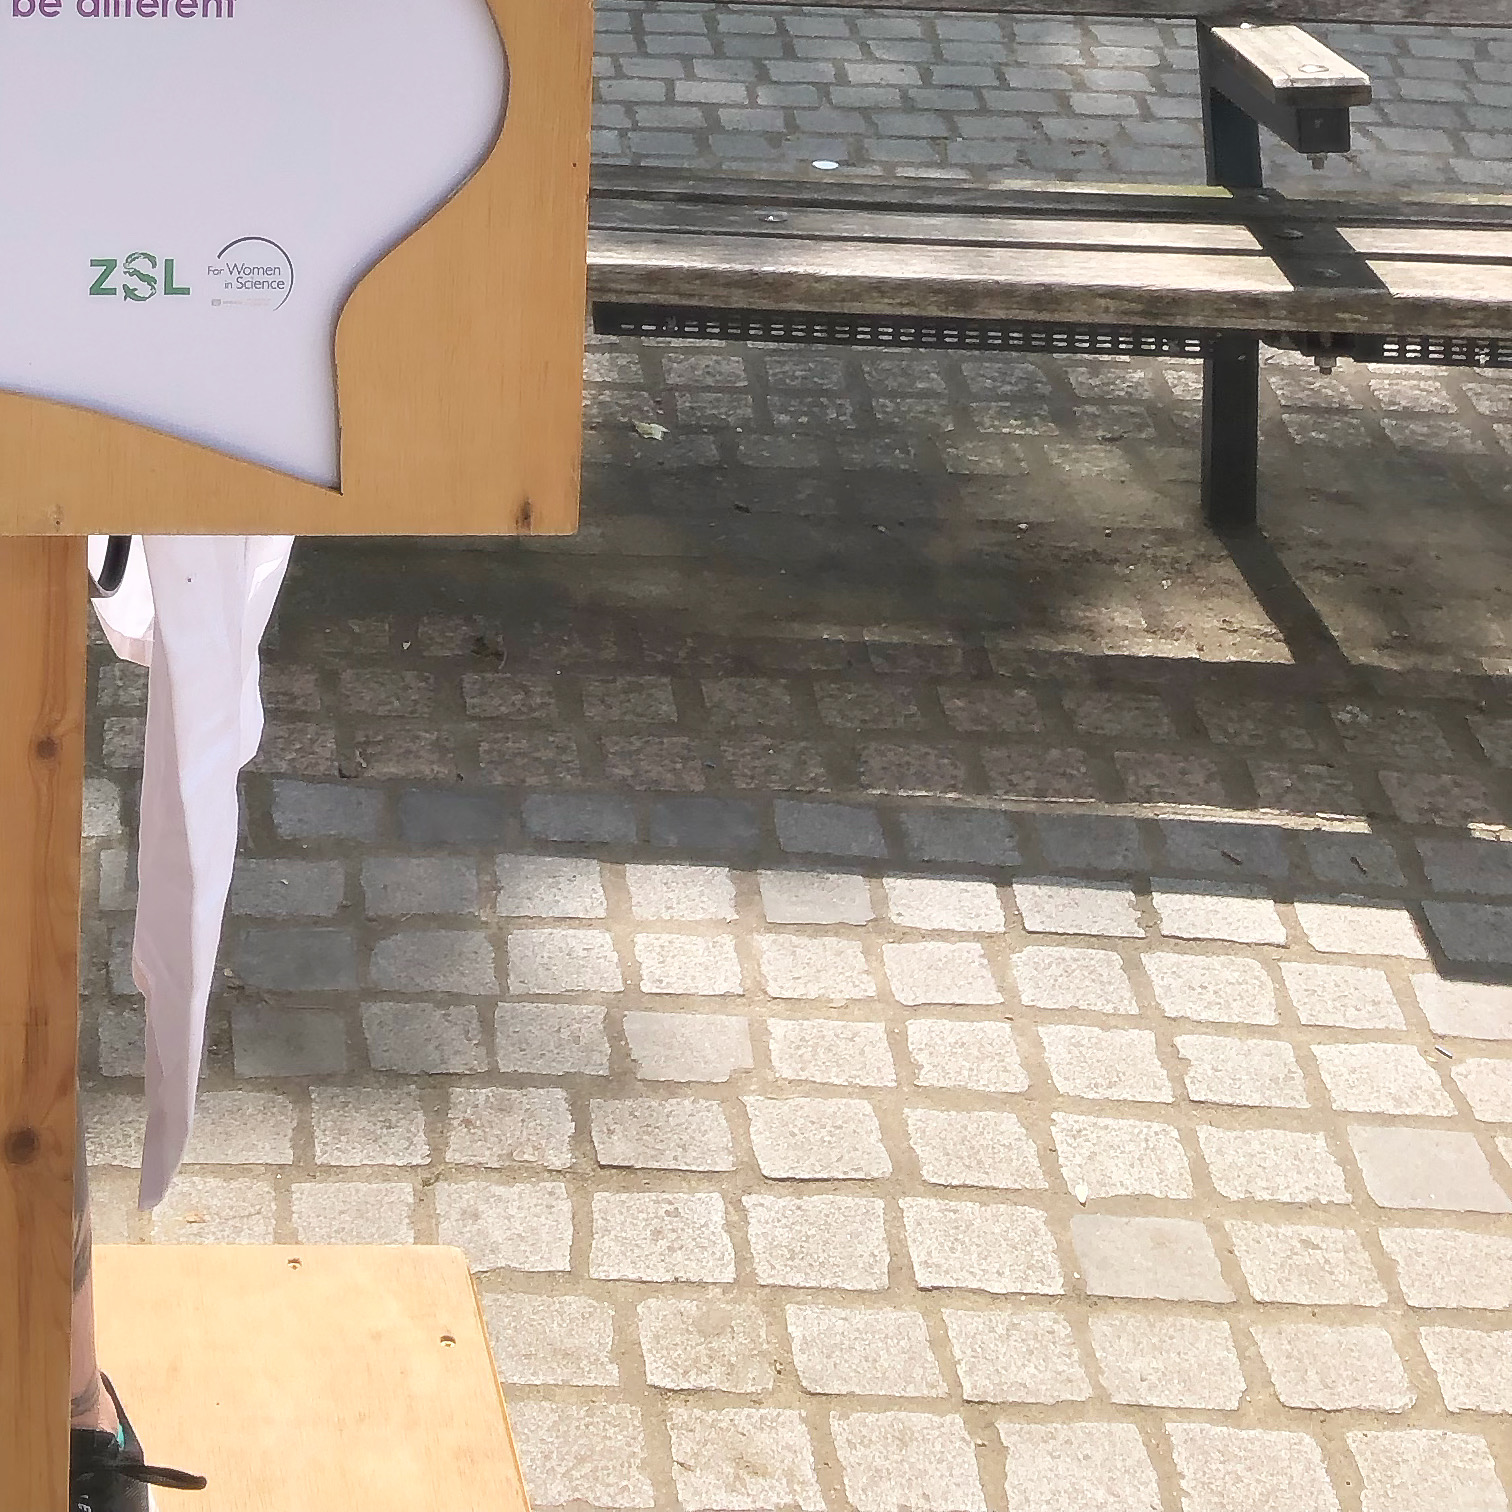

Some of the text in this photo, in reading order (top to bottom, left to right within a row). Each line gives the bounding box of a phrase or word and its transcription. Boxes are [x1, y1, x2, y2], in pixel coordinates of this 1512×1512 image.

[207, 262, 281, 276] For Women
[89, 251, 191, 302] ZSL
[224, 276, 286, 290] in Science
